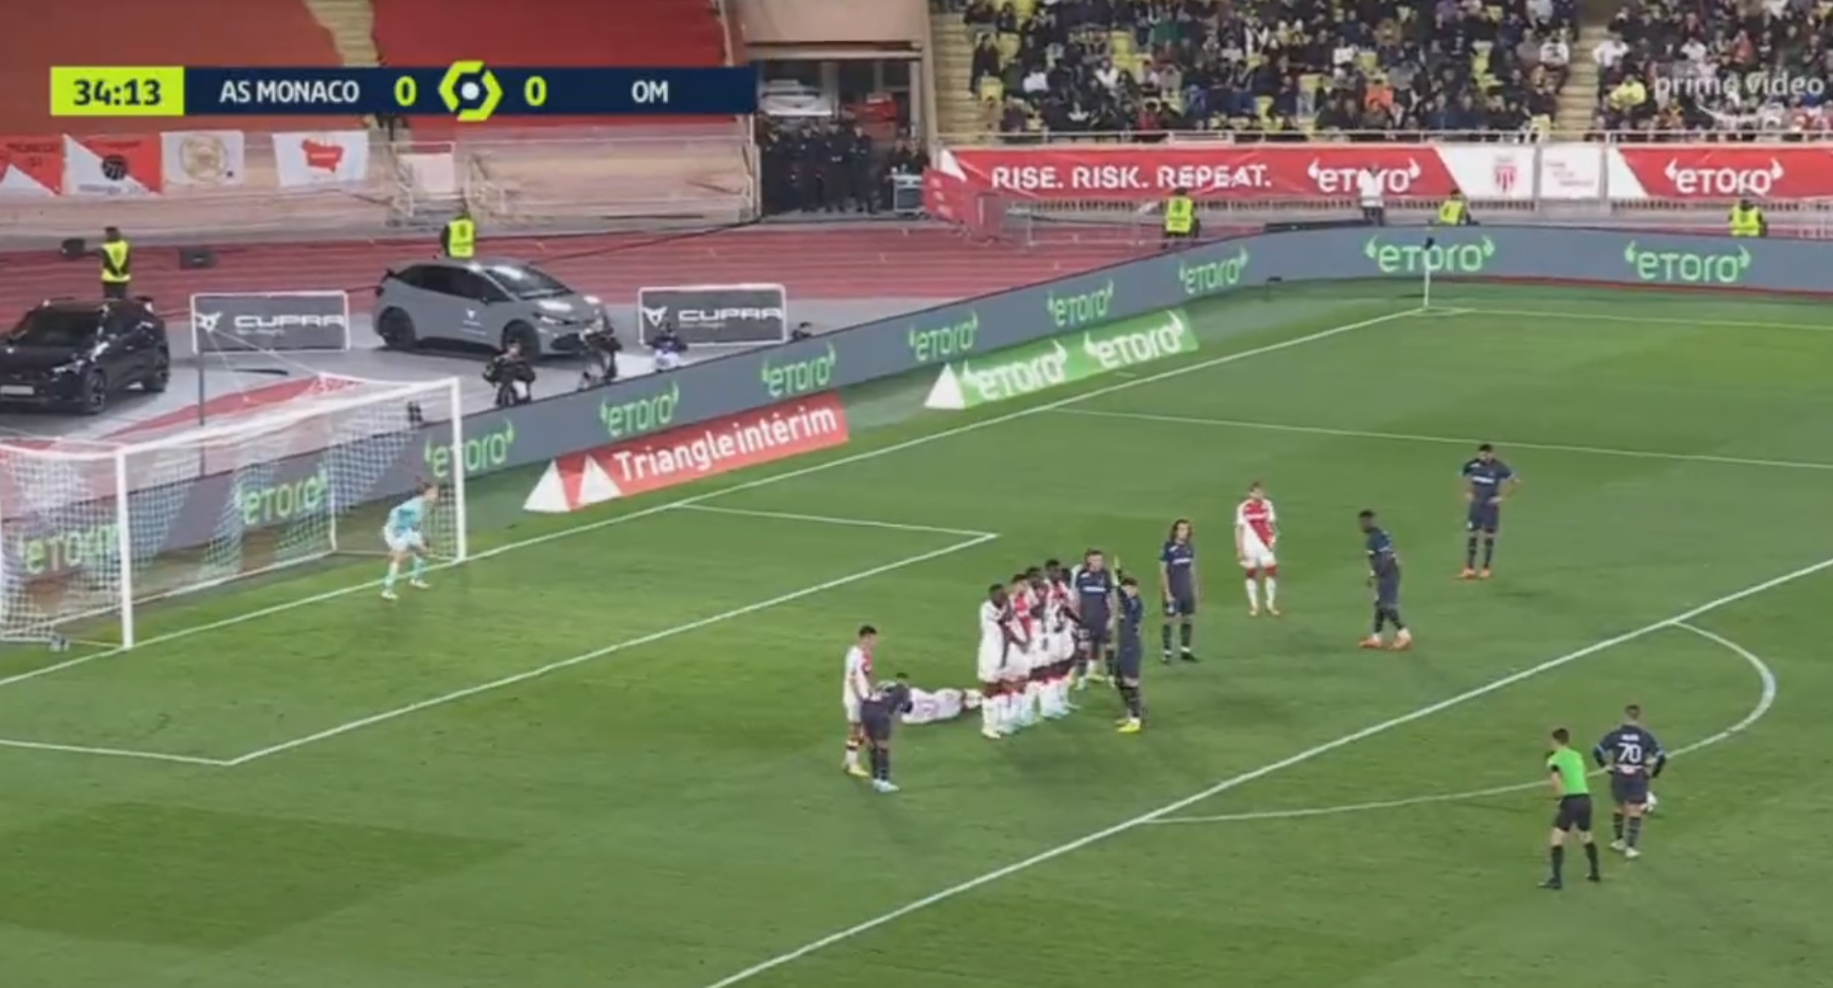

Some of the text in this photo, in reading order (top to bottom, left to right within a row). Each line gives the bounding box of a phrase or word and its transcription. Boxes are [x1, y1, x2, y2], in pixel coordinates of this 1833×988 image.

[991, 164, 1272, 189] RISE. RISK. REPEAT.
[234, 314, 346, 328] CUPRA
[678, 307, 783, 322] CUPRA
[1617, 742, 1642, 764] 70
